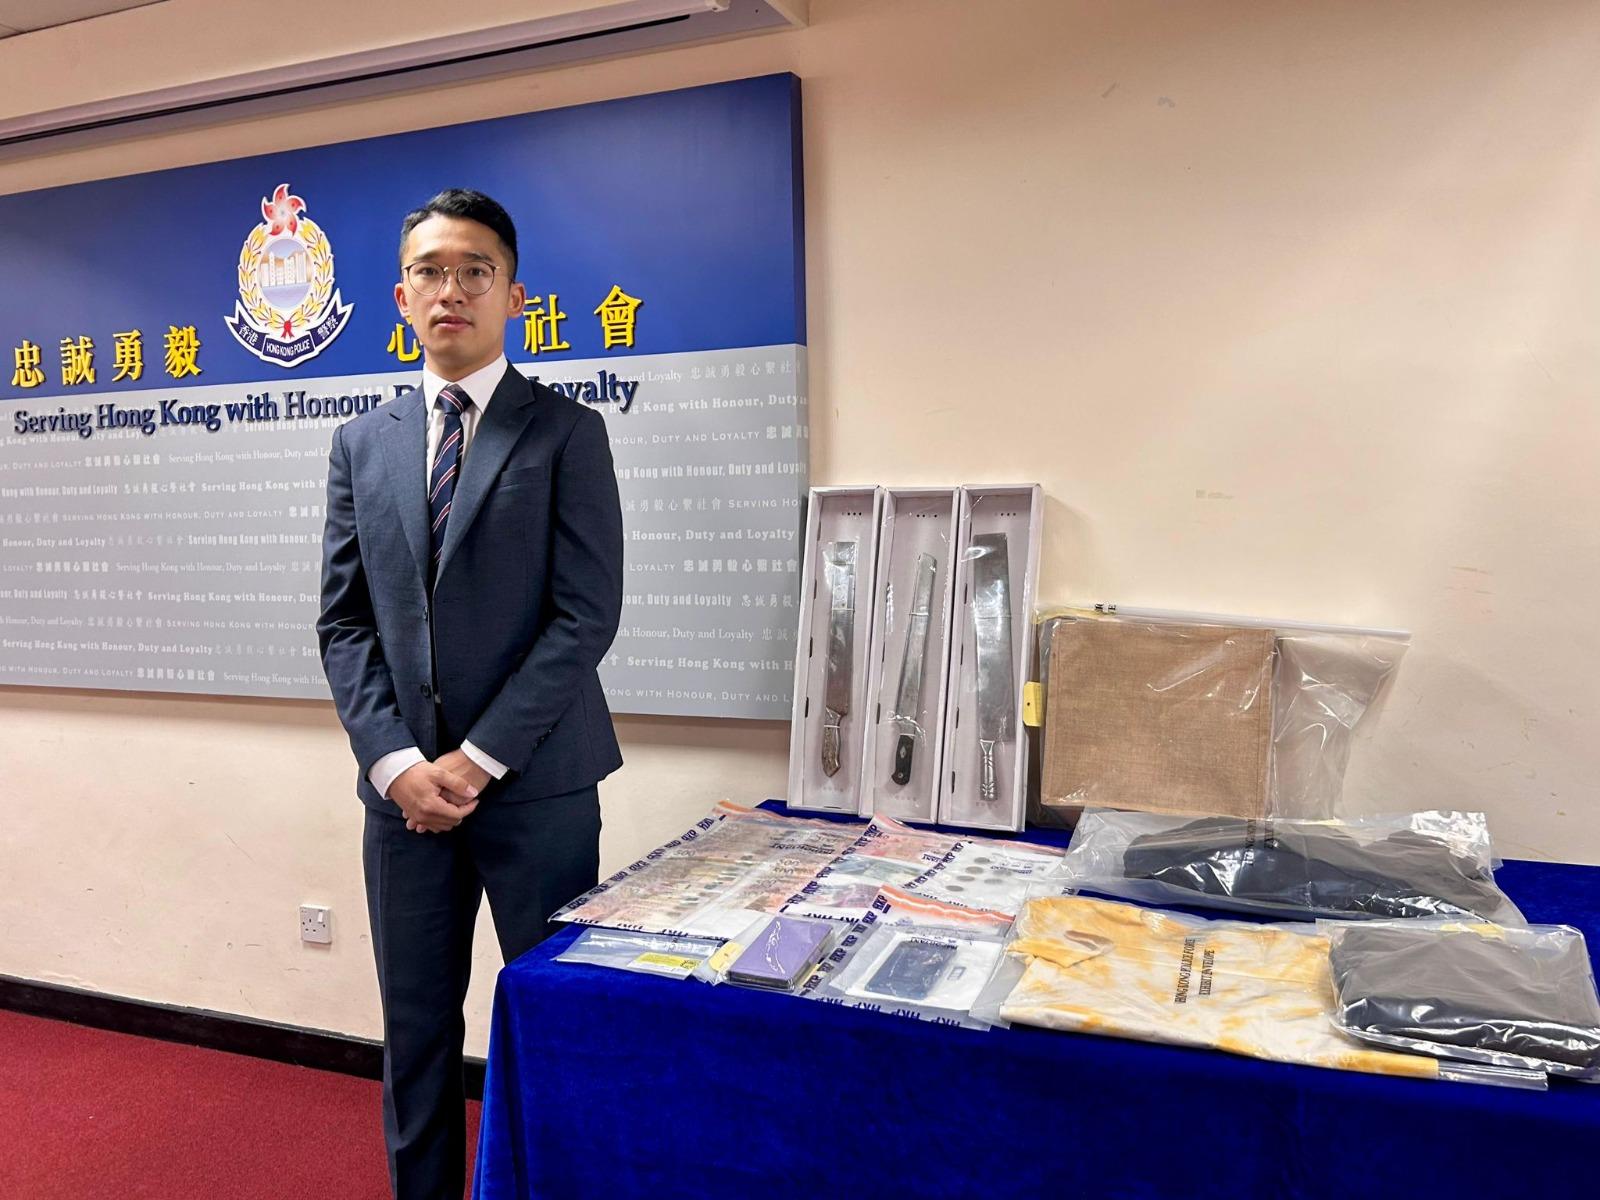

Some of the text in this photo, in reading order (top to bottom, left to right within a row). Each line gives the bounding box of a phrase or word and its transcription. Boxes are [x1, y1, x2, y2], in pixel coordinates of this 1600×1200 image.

[239, 324, 259, 346] 香港
[317, 315, 339, 340] 警察
[266, 339, 310, 357] HONG KONG POLICE
[12, 325, 202, 388] 忠誠勇毅
[648, 369, 683, 383] Loyalty
[643, 401, 675, 413] Kong
[678, 399, 708, 410] with
[712, 396, 764, 409] Honour,
[768, 394, 797, 407] Duty
[14, 407, 93, 438] Serving
[96, 403, 156, 436] Hong
[158, 399, 222, 434] Kong
[223, 392, 280, 424] with
[633, 466, 658, 479] Kong
[661, 465, 684, 477] with
[686, 464, 726, 477] Honour,
[728, 463, 752, 476] Duty
[755, 462, 774, 473] and
[201, 482, 237, 493] Serving
[239, 482, 262, 493] Hong
[265, 480, 290, 492] Kong
[292, 479, 316, 489] with
[37, 537, 55, 548] Duty
[58, 537, 73, 547] and
[75, 536, 106, 548] Loyalty
[632, 528, 795, 542] Honour, Duty and Loyalty
[148, 591, 181, 602] Serving
[183, 592, 206, 603] Hong
[208, 592, 231, 603] Kong
[233, 592, 256, 601] with
[259, 593, 297, 604] Honour,
[647, 593, 669, 607] Duty
[672, 594, 691, 606] and
[694, 594, 732, 607] Loyalty
[632, 627, 670, 639] Honour,
[673, 627, 696, 641] Duty
[698, 628, 716, 639] and
[719, 627, 754, 642] Loyalty
[2, 638, 33, 650] Serving
[80, 640, 99, 650] with
[102, 641, 136, 652] Honour,
[138, 642, 158, 654] Duty
[161, 643, 177, 653] and
[180, 644, 212, 655] Loyalty
[627, 656, 674, 669] Serving
[678, 657, 709, 670] Hong
[713, 658, 745, 671] Kong
[750, 659, 780, 670] with
[272, 673, 292, 685] Kong
[293, 674, 310, 685] with
